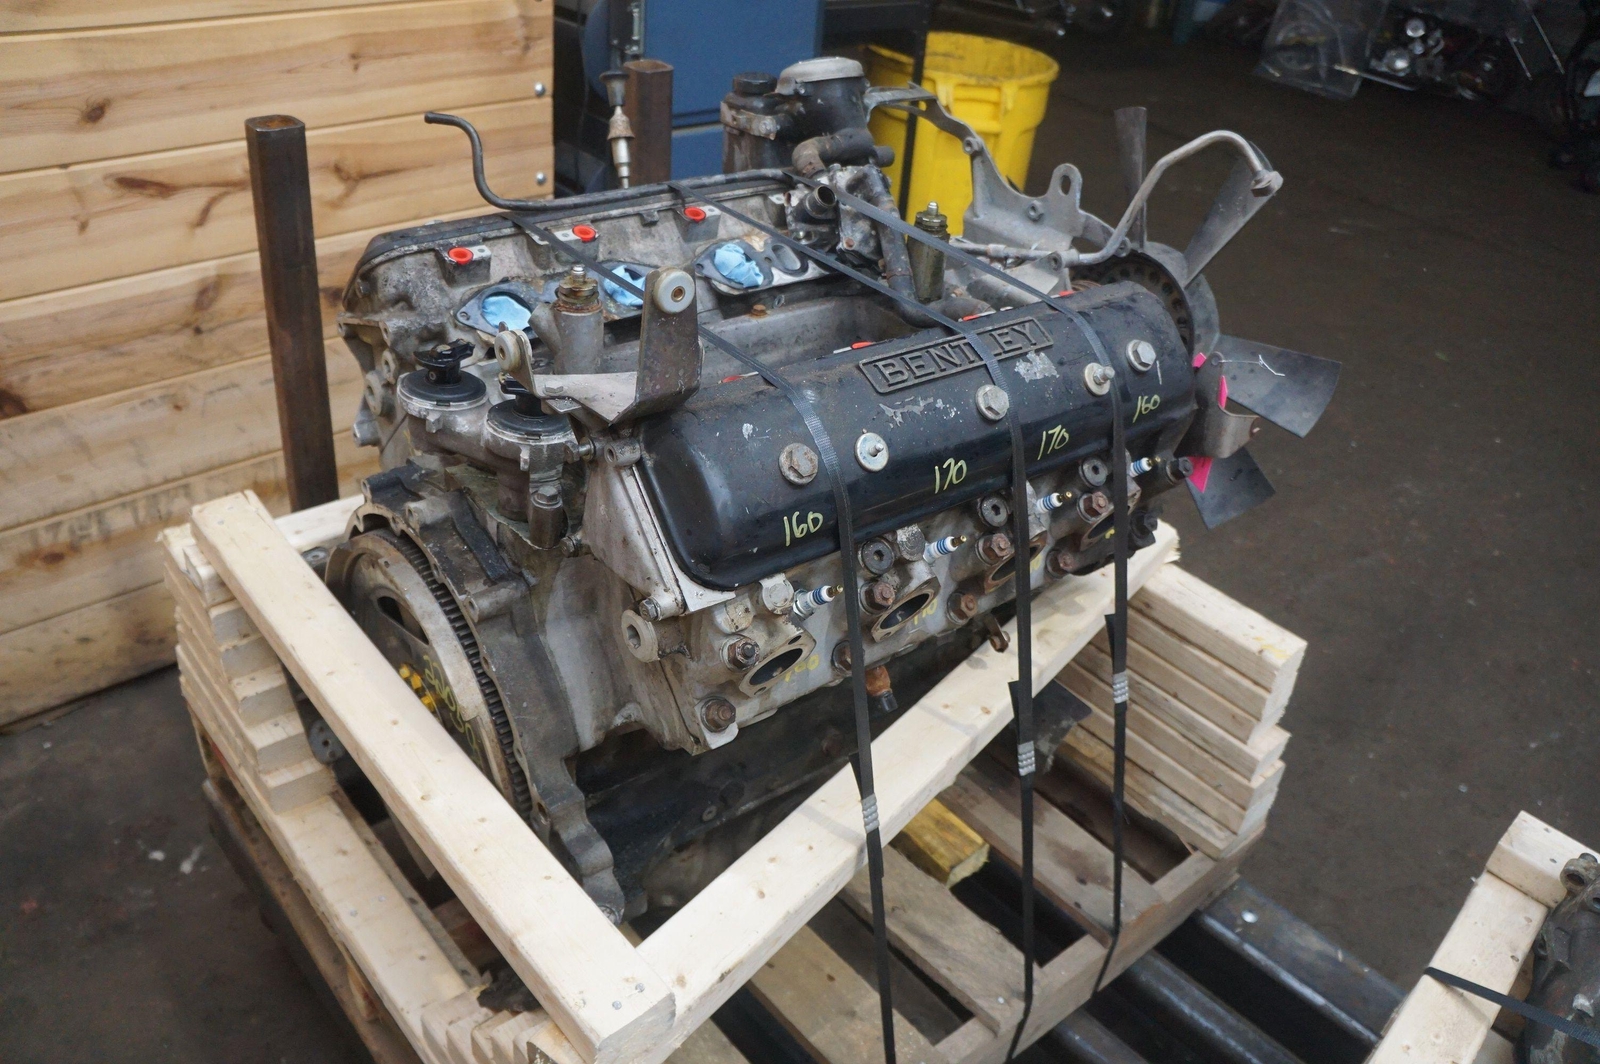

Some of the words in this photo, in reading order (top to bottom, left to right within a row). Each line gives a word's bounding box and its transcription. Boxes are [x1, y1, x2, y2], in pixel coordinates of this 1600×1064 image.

[872, 322, 1037, 387] BENTEY
[1133, 394, 1161, 423] 160
[1038, 424, 1070, 460] 170
[934, 457, 967, 494] 170
[783, 511, 824, 546] 160
